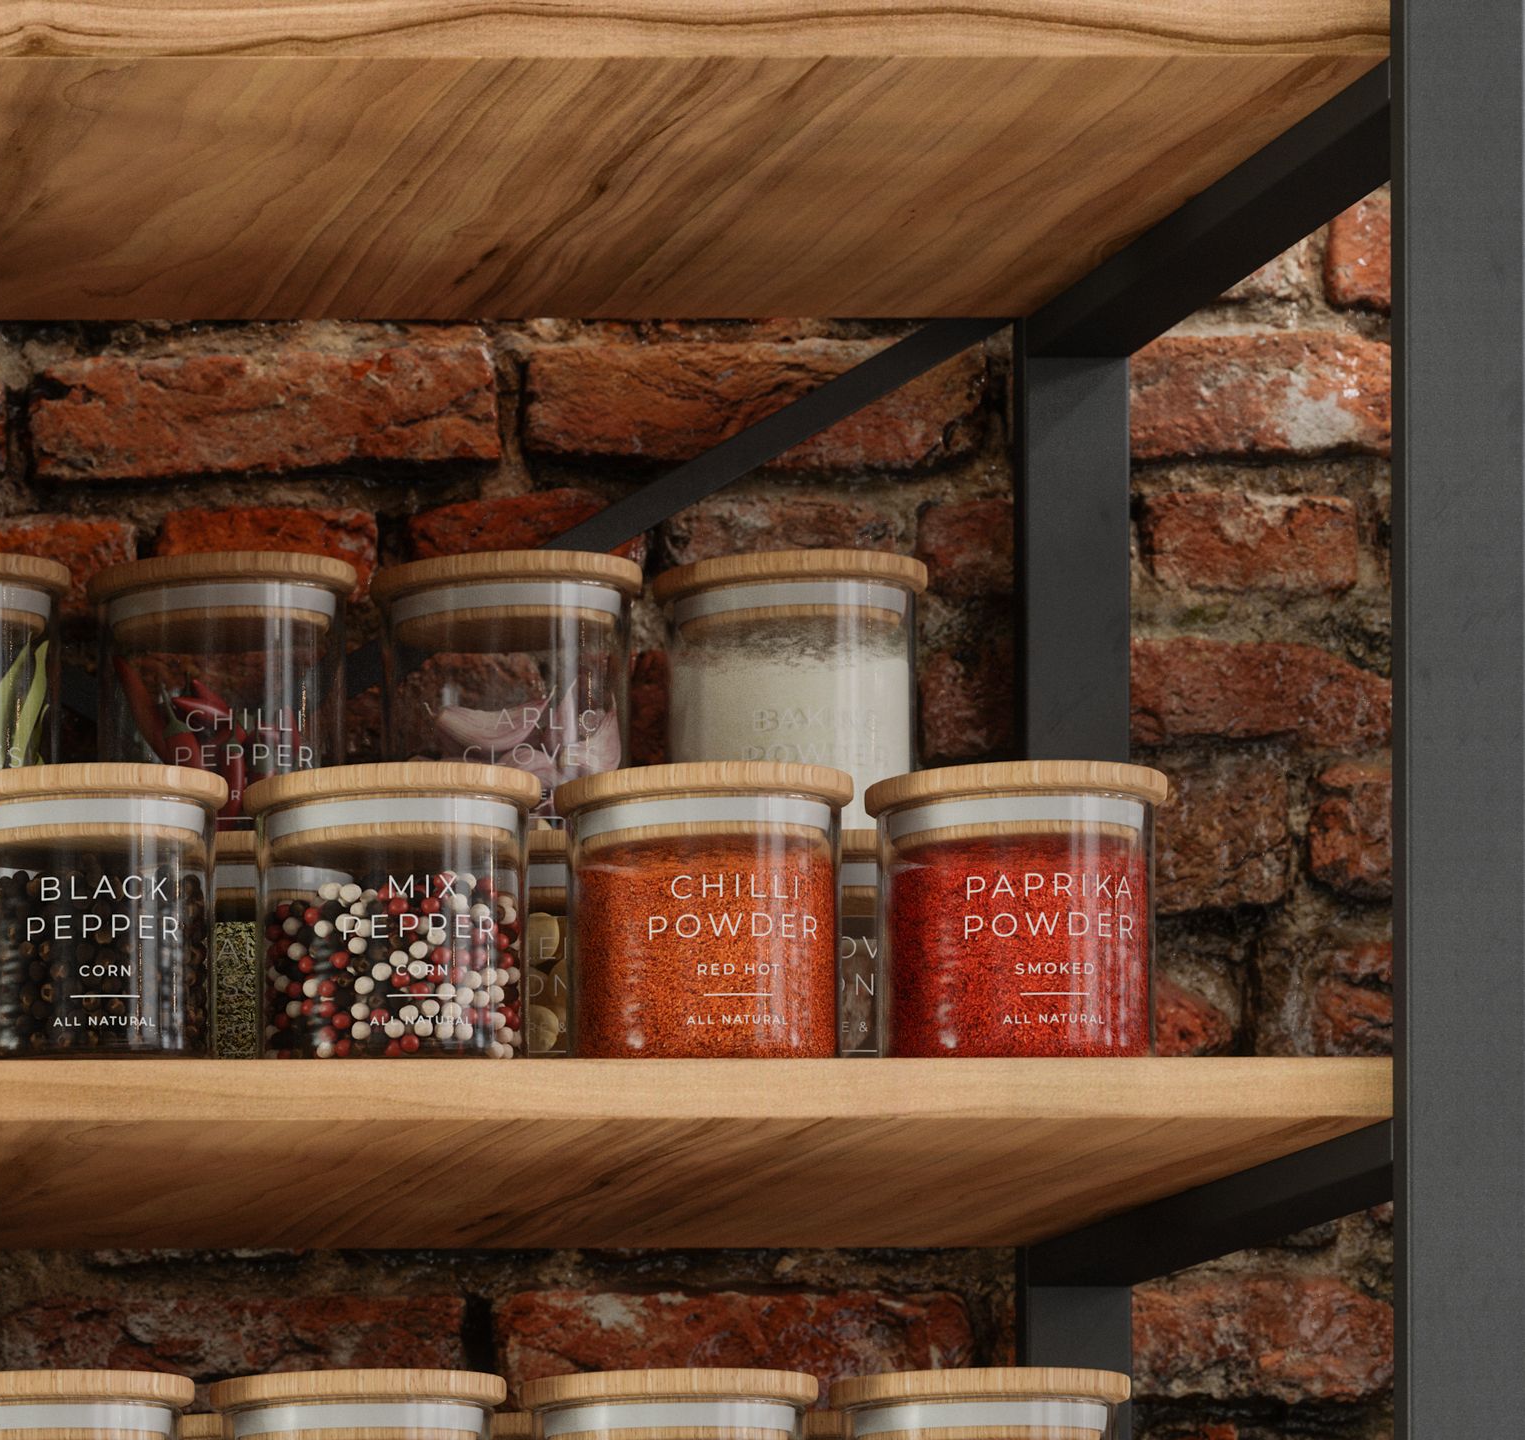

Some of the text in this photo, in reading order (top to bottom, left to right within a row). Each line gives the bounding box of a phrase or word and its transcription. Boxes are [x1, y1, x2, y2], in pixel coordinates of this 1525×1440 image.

[186, 708, 302, 733] CHILLI
[174, 744, 314, 769] PEPPER
[39, 876, 168, 902] BLACK
[387, 874, 457, 899] MIX
[671, 874, 799, 900] CHILLI
[966, 872, 1133, 900] PAPRIKA
[27, 915, 179, 941] PEPPER
[343, 914, 495, 940] PEPPER
[648, 912, 818, 940] POWDER
[963, 911, 1134, 940] POWDER
[79, 964, 131, 978] CORN
[395, 963, 448, 977] CORN
[697, 962, 780, 976] RED HOT
[1014, 962, 1095, 976] SMOKED
[53, 1015, 156, 1028] ALL NATURAL
[370, 1014, 472, 1027] ALL NATURAL
[686, 1013, 788, 1026] ALL NATURAL
[1003, 1013, 1105, 1025] ALL NATURAL
